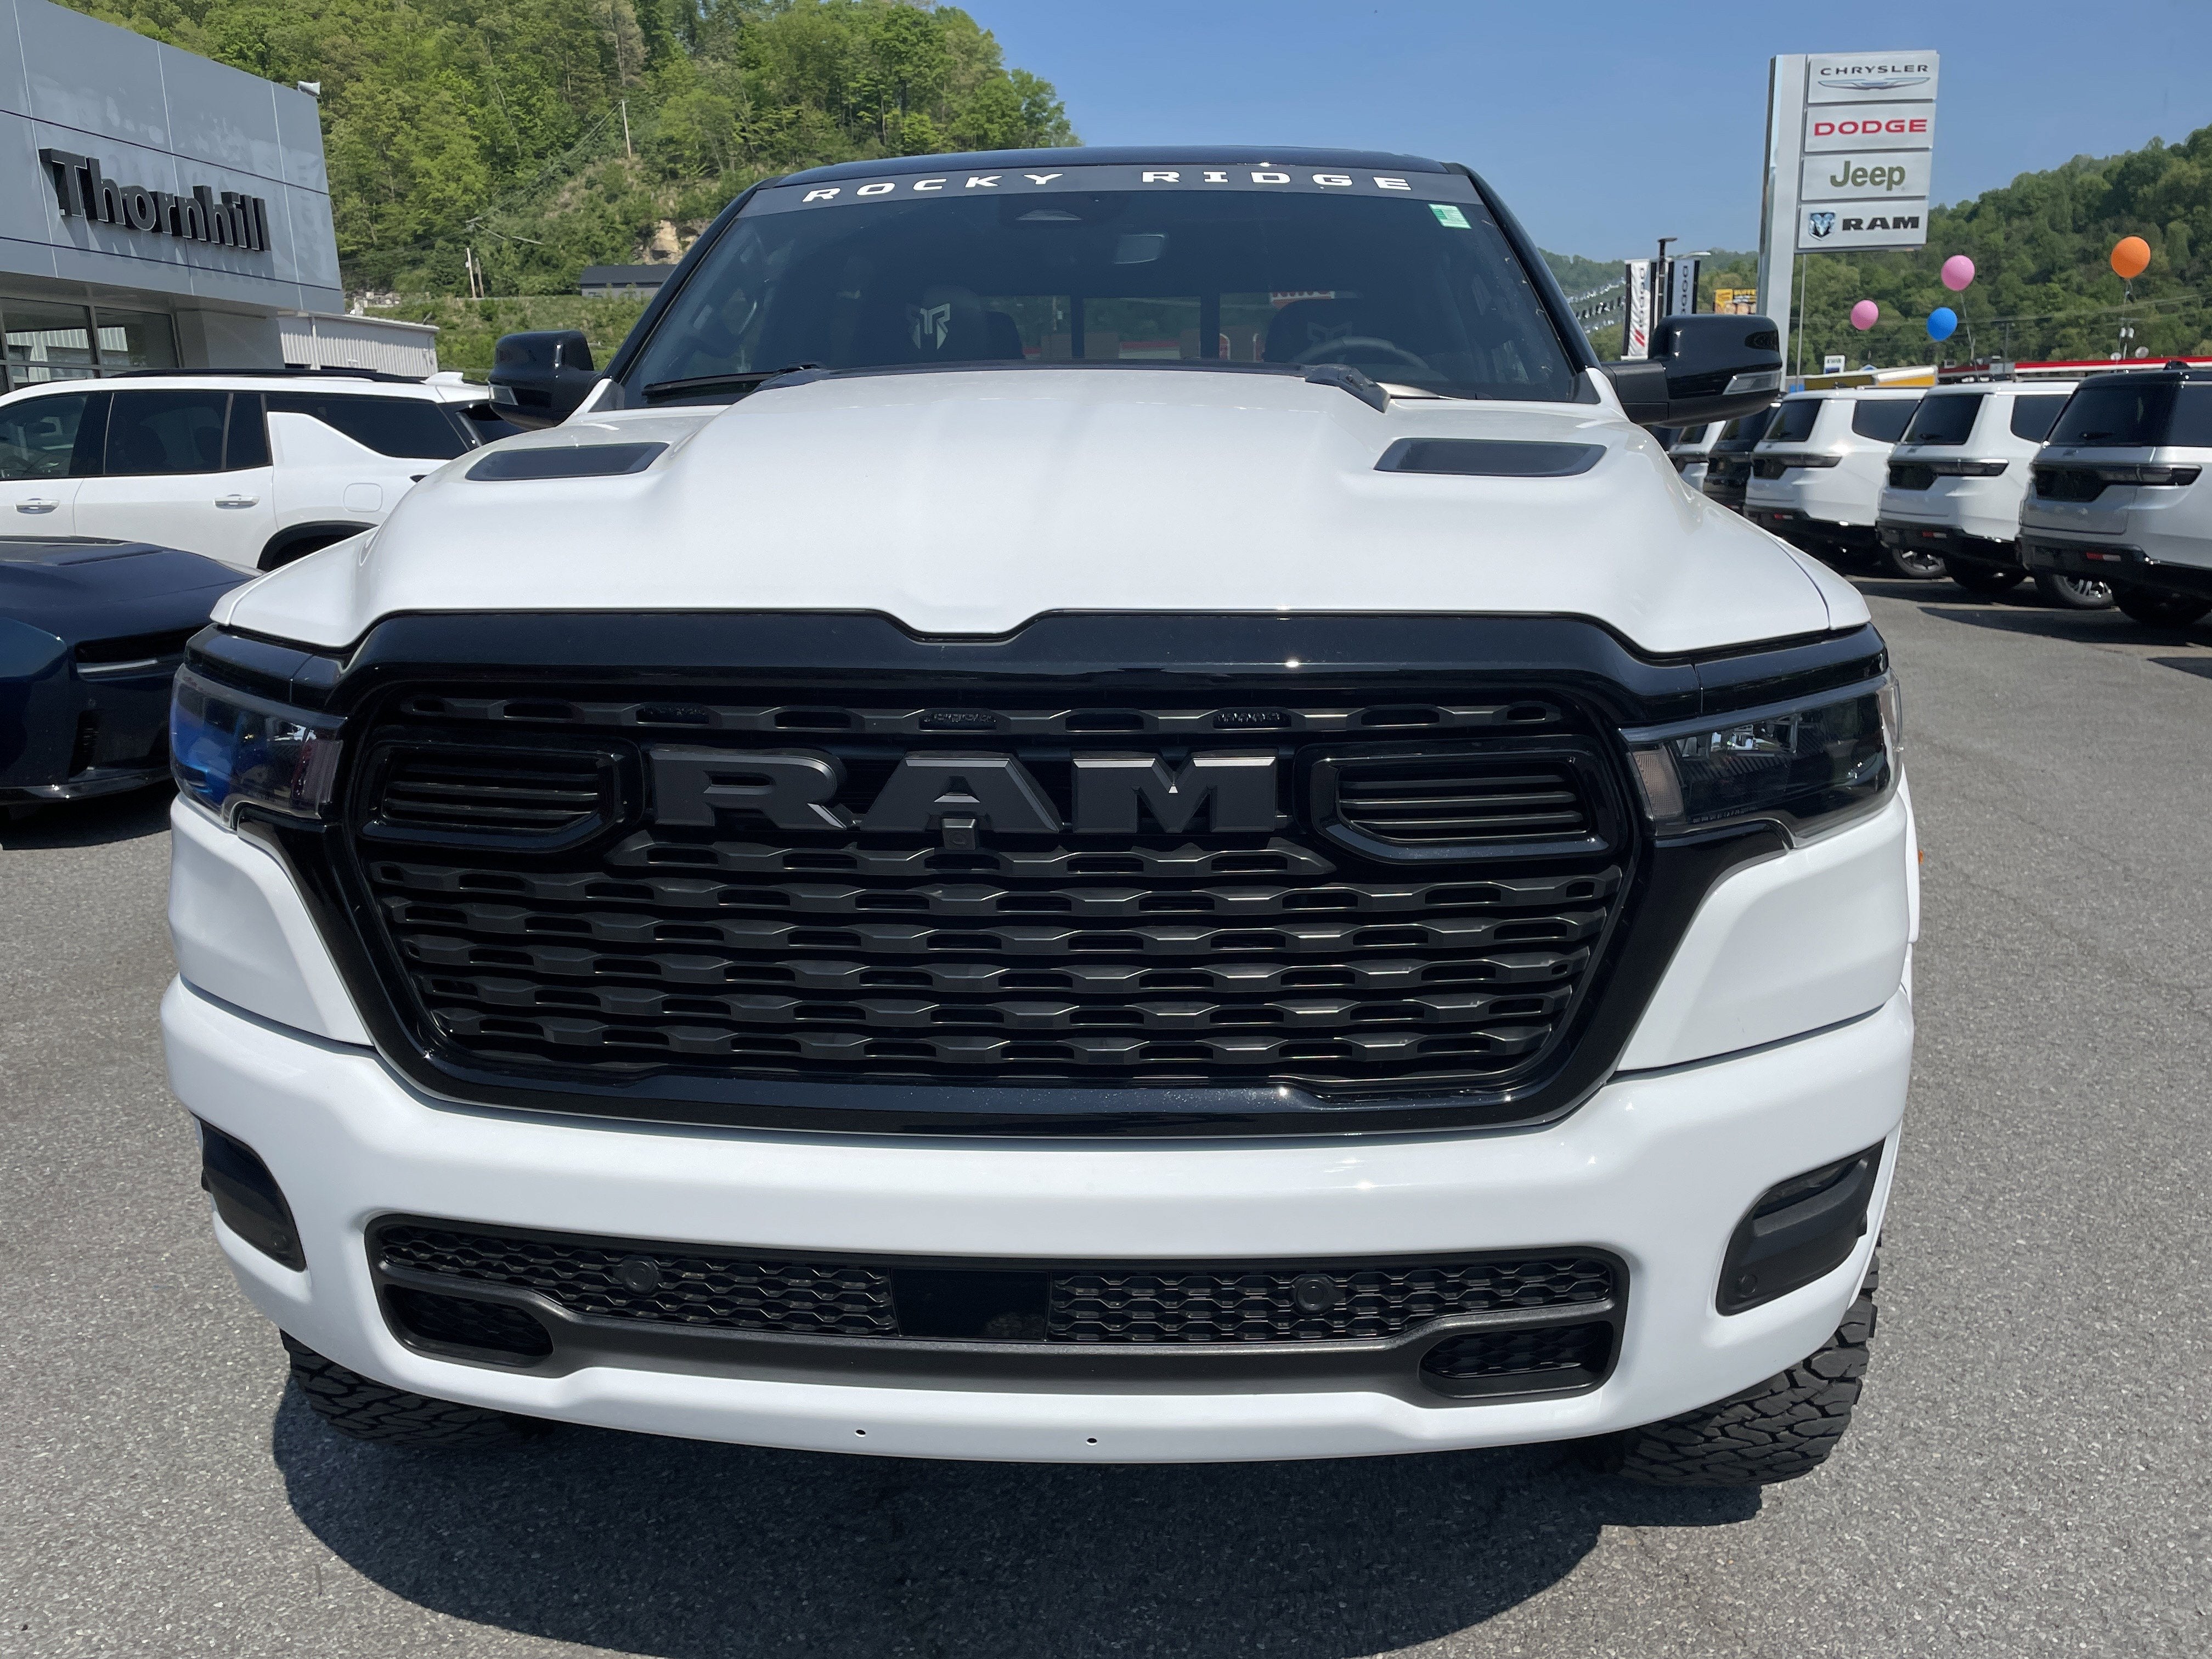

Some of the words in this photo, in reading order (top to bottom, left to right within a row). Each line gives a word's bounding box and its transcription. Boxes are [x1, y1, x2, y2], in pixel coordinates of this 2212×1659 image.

[1820, 64, 1929, 76] CHRYSLER
[1814, 119, 1928, 137] DODGE
[802, 173, 1063, 202] ROCKY
[1142, 171, 1412, 190] RIDGE
[1830, 161, 1905, 191] Jeep
[39, 148, 272, 251] Thornhill
[1842, 216, 1920, 231] RAM
[652, 748, 1277, 834] RAM
